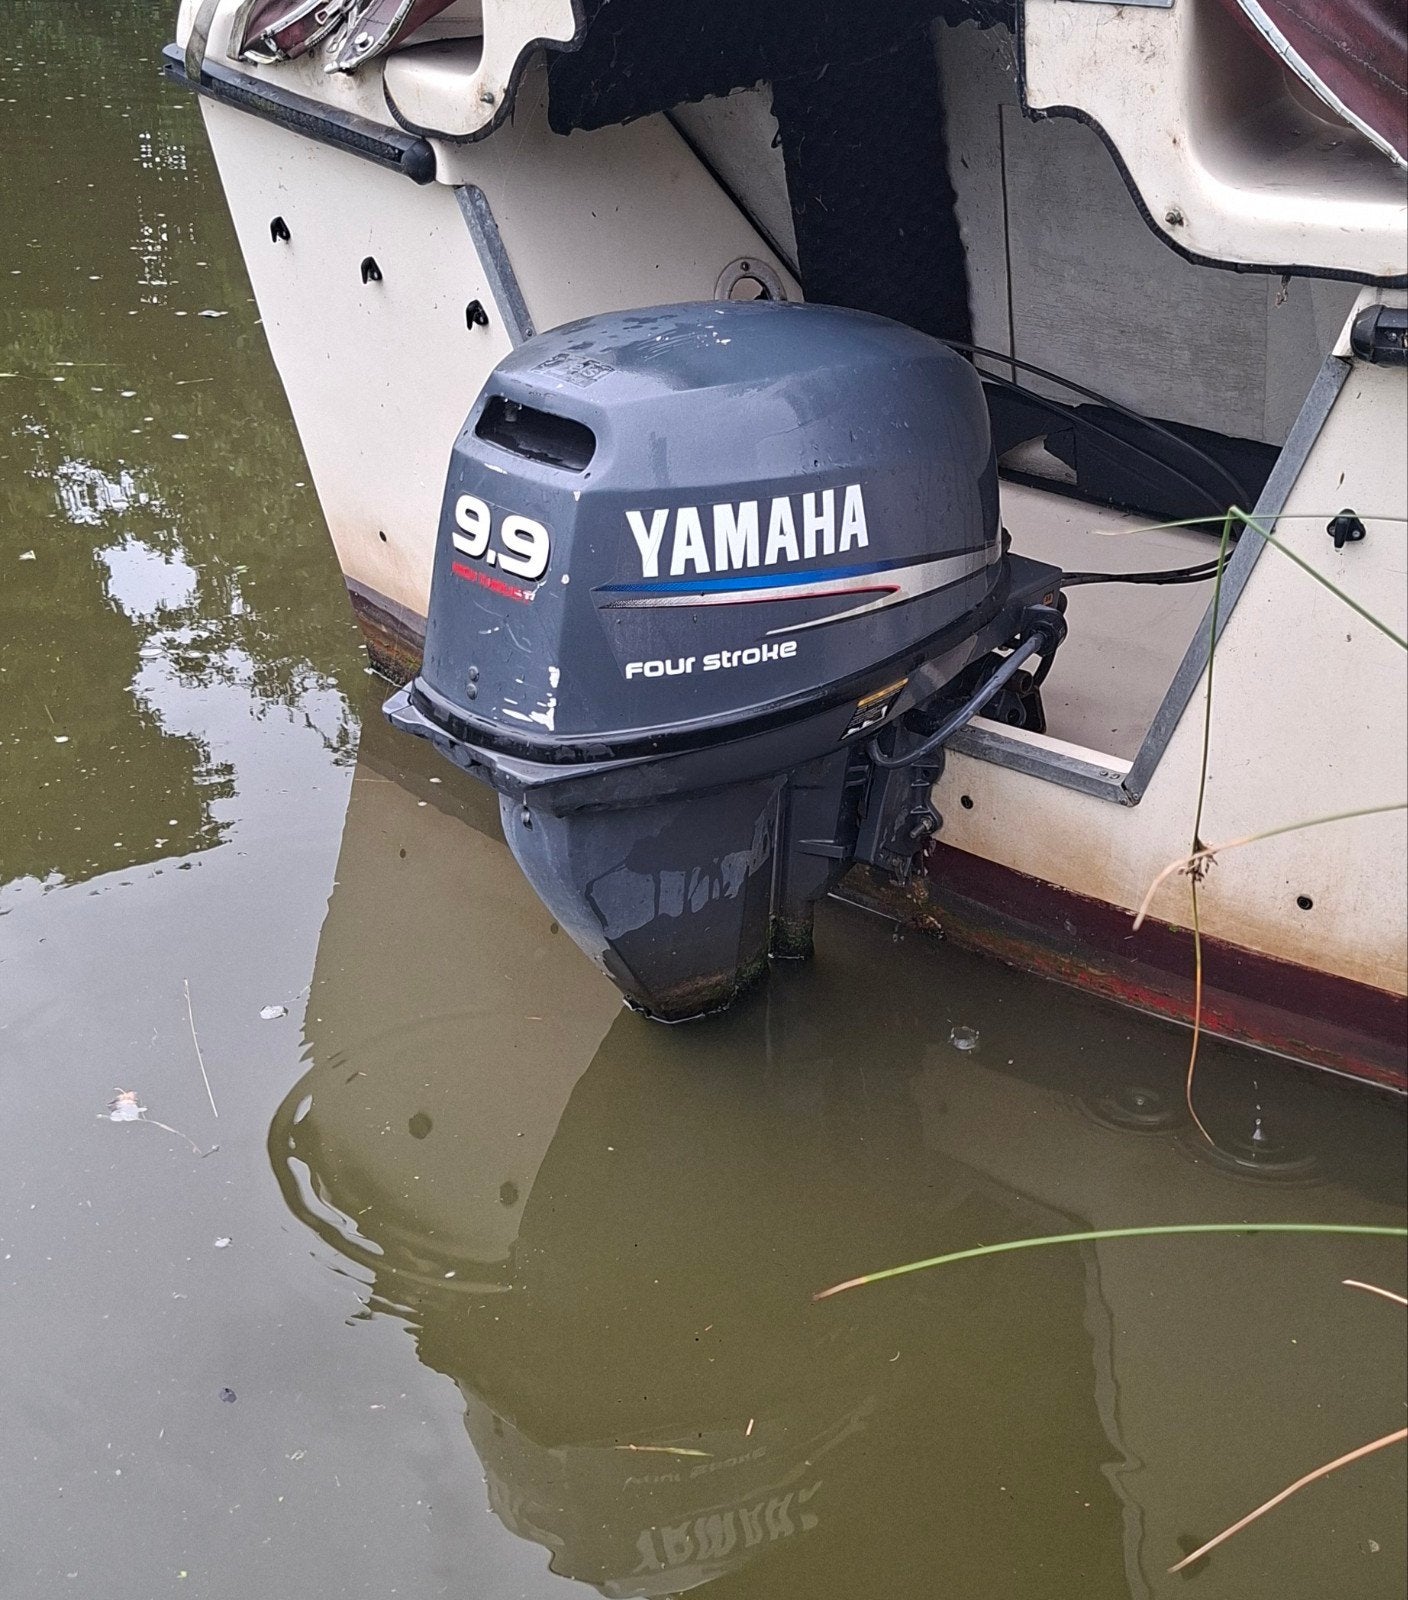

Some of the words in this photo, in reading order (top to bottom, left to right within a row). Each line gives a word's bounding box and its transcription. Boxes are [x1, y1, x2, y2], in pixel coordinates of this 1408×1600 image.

[452, 494, 551, 582] 9.9
[625, 484, 869, 578] YAMAHA
[702, 640, 798, 671] stroke
